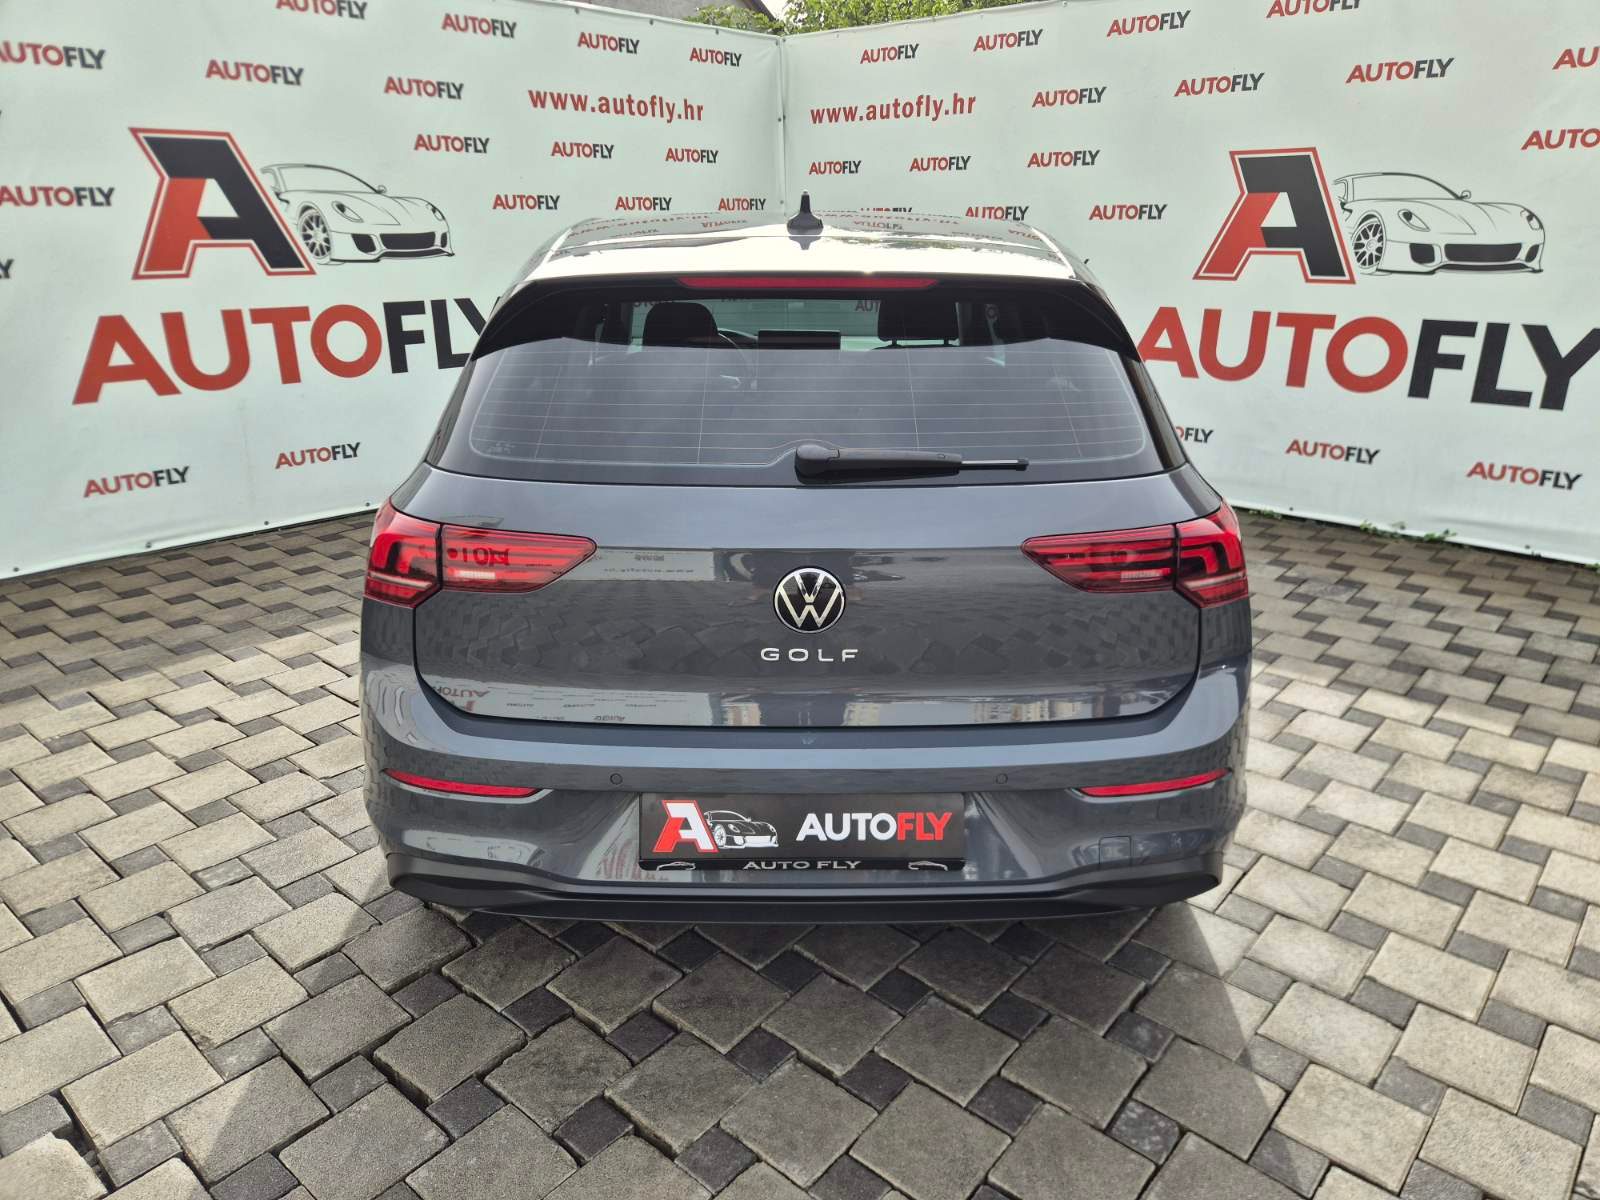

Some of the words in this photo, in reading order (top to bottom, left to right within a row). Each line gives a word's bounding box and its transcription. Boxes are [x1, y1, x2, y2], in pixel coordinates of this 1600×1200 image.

[442, 13, 517, 38] AUTOFLY
[1107, 10, 1191, 37] AUTOFLY
[578, 32, 640, 54] AUTOFLY
[973, 29, 1043, 52] AUTOFLY
[690, 48, 742, 67] AUTOFLY
[860, 44, 919, 64] AUTOFLY
[206, 60, 304, 86] AUTOFLY
[1346, 58, 1454, 83] AUTOFLY
[384, 77, 464, 100] AUTOFLY
[1174, 73, 1264, 97] AUTOFLY
[528, 90, 703, 123] www.autofly.hr
[1032, 87, 1107, 108] AUTOFLY
[810, 93, 976, 124] www.autofly.hr
[414, 134, 489, 153] AUTOFLY
[551, 142, 614, 159] AUTOFLY
[665, 148, 719, 163] AUTOFLY
[909, 156, 971, 172] AUTOFLY
[1027, 150, 1100, 167] AUTOFLY
[809, 160, 861, 175] AUTOFLY
[0, 186, 114, 206] AUTOFLY
[493, 194, 560, 210] AUTOFLY
[615, 197, 672, 211] AUTOFLY
[718, 198, 766, 211] AUTOFLY
[1089, 204, 1167, 220] AUTOFLY
[1137, 306, 1600, 412] AUTOFLY
[275, 442, 360, 469] AUTOFLY
[1286, 440, 1380, 465] AUTOFLY
[84, 466, 189, 497] AUTOFLY
[1467, 462, 1582, 490] AUTOFLY
[761, 648, 858, 662] GOLF
[795, 812, 952, 841] AUTOFLY
[743, 861, 810, 870] AUTO
[816, 861, 861, 870] FLY
